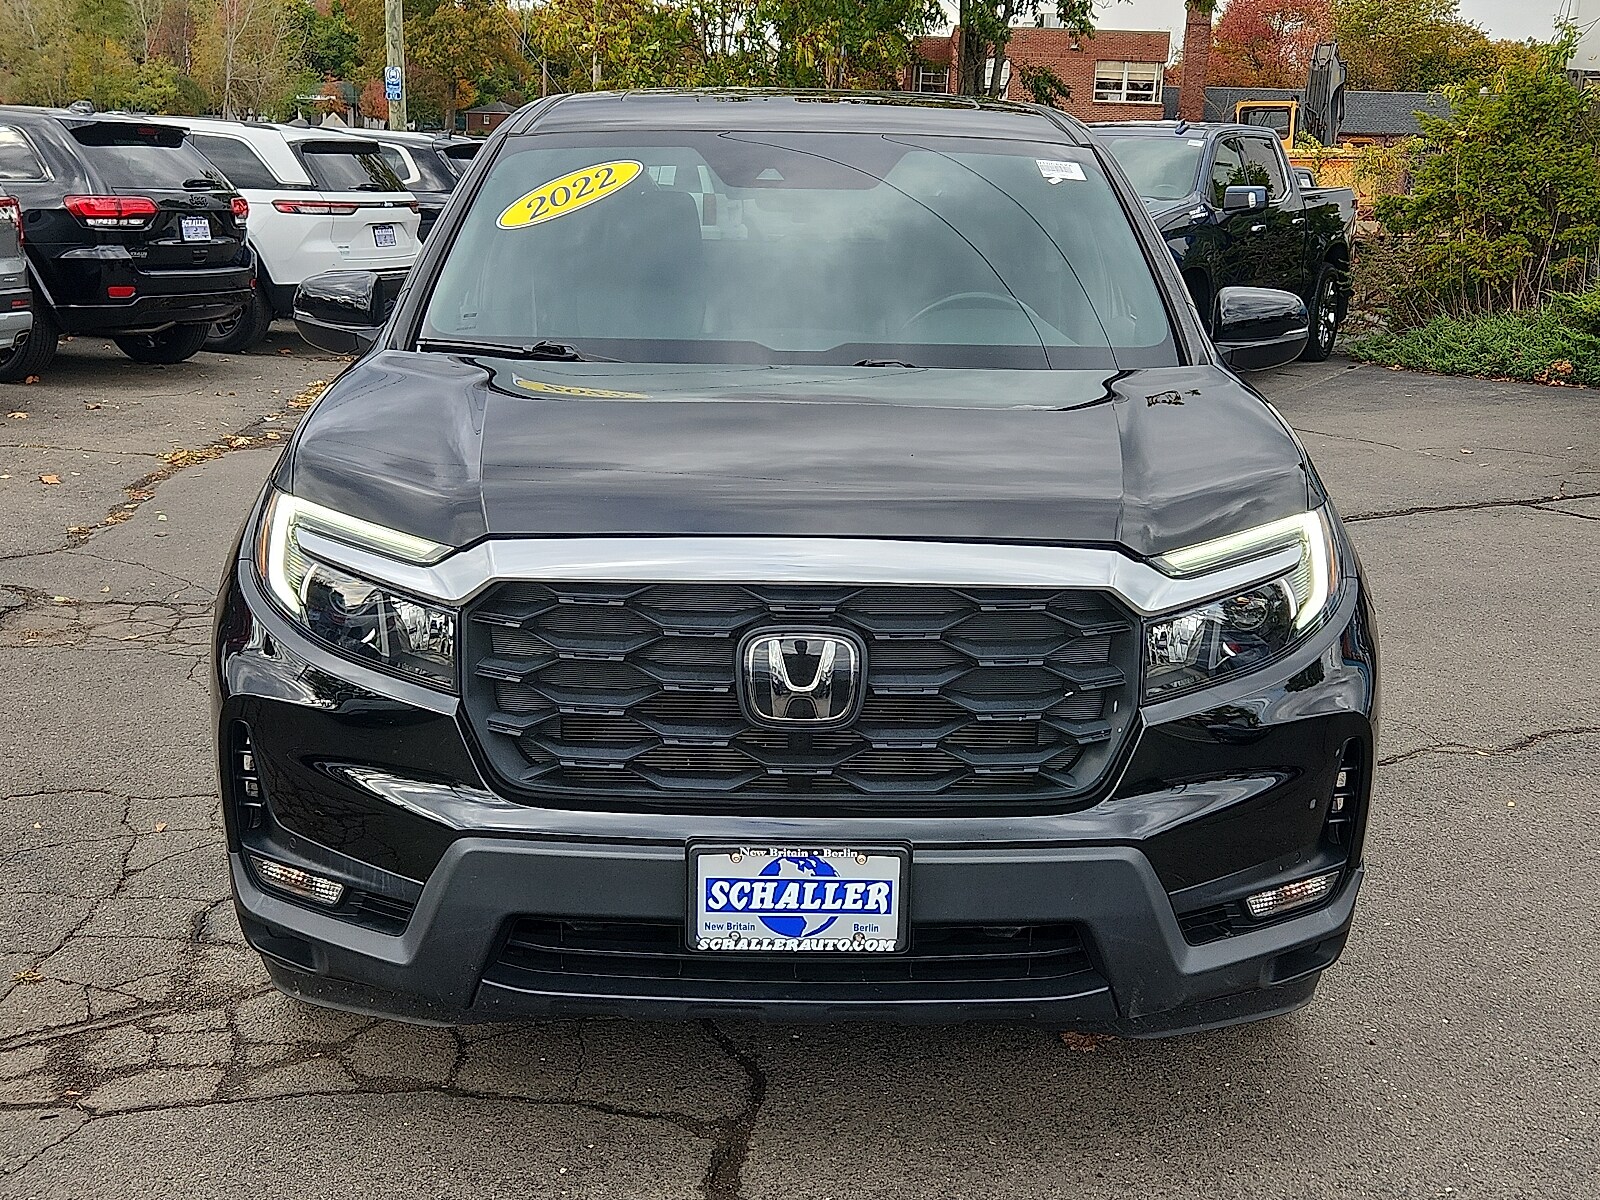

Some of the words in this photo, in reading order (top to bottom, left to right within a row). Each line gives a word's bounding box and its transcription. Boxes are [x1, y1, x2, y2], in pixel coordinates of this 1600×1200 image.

[527, 167, 617, 220] 2022
[740, 847, 767, 857] New
[769, 847, 809, 858] Britain
[823, 848, 858, 858] Berlin
[707, 880, 890, 915] SCHALLER
[704, 921, 724, 931] New
[726, 921, 756, 931] Britain
[853, 923, 879, 933] Berlin
[696, 938, 898, 952] SCHALLERAUTO.COM
